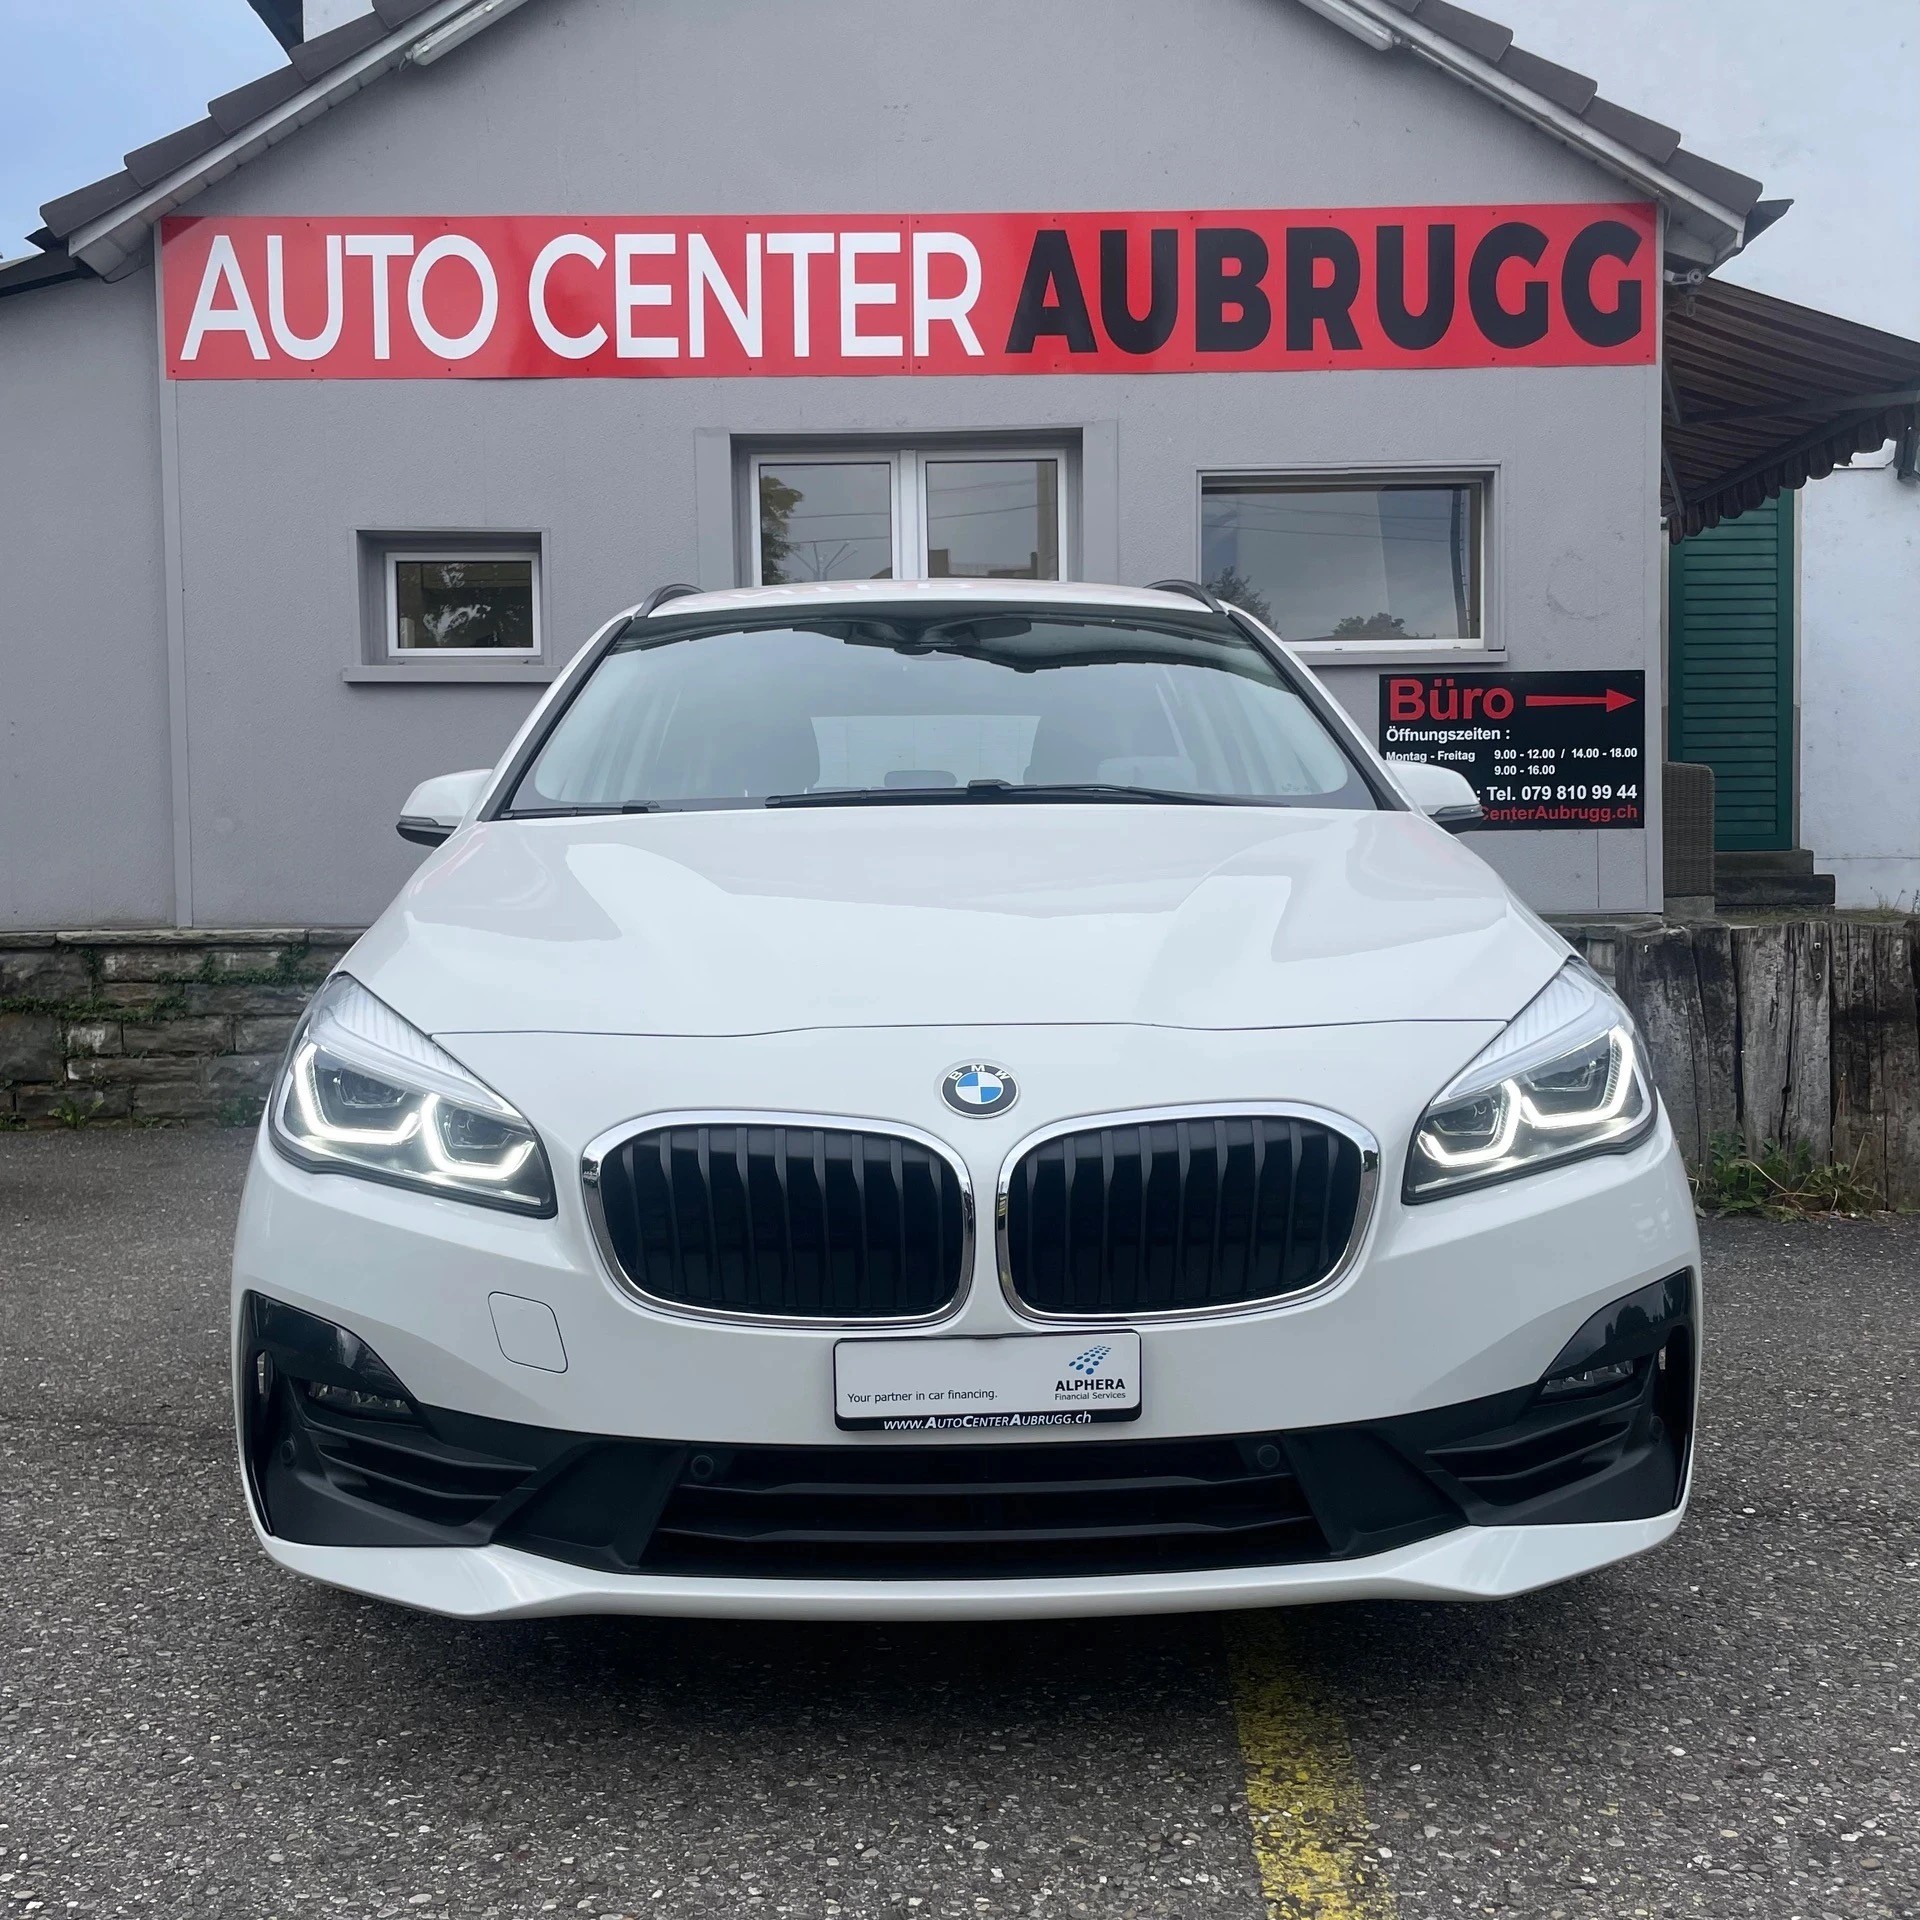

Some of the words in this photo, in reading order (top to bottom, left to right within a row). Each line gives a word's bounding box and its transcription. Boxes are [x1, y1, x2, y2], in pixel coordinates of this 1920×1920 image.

[179, 233, 499, 362] AUTO
[528, 231, 985, 360] CENTER
[1004, 220, 1642, 355] AUBRUGG
[1389, 678, 1514, 721] Büro
[1386, 726, 1501, 744] Öffnungszeiten
[1386, 751, 1427, 763] Montag
[1437, 750, 1476, 763] Freitag
[1494, 749, 1517, 760] 9.00
[1527, 748, 1556, 759] 12.00
[1571, 748, 1600, 759] 14.00
[1609, 747, 1638, 758] 18.00
[1494, 765, 1517, 776] 9.00
[1527, 764, 1556, 775] 16.00
[1486, 786, 1516, 801] Tel.
[1521, 785, 1552, 801] 079
[1556, 784, 1587, 800] 810
[1591, 784, 1612, 800] 99
[1616, 784, 1638, 799] 44
[948, 1064, 1011, 1081] BMW
[1055, 1378, 1126, 1391] ALPHERA
[847, 1392, 872, 1403] Your
[874, 1391, 913, 1404] partner
[915, 1390, 925, 1400] in
[928, 1391, 945, 1400] car
[948, 1389, 998, 1401] financing.
[1054, 1392, 1090, 1400] Financial
[1092, 1391, 1126, 1399] Services
